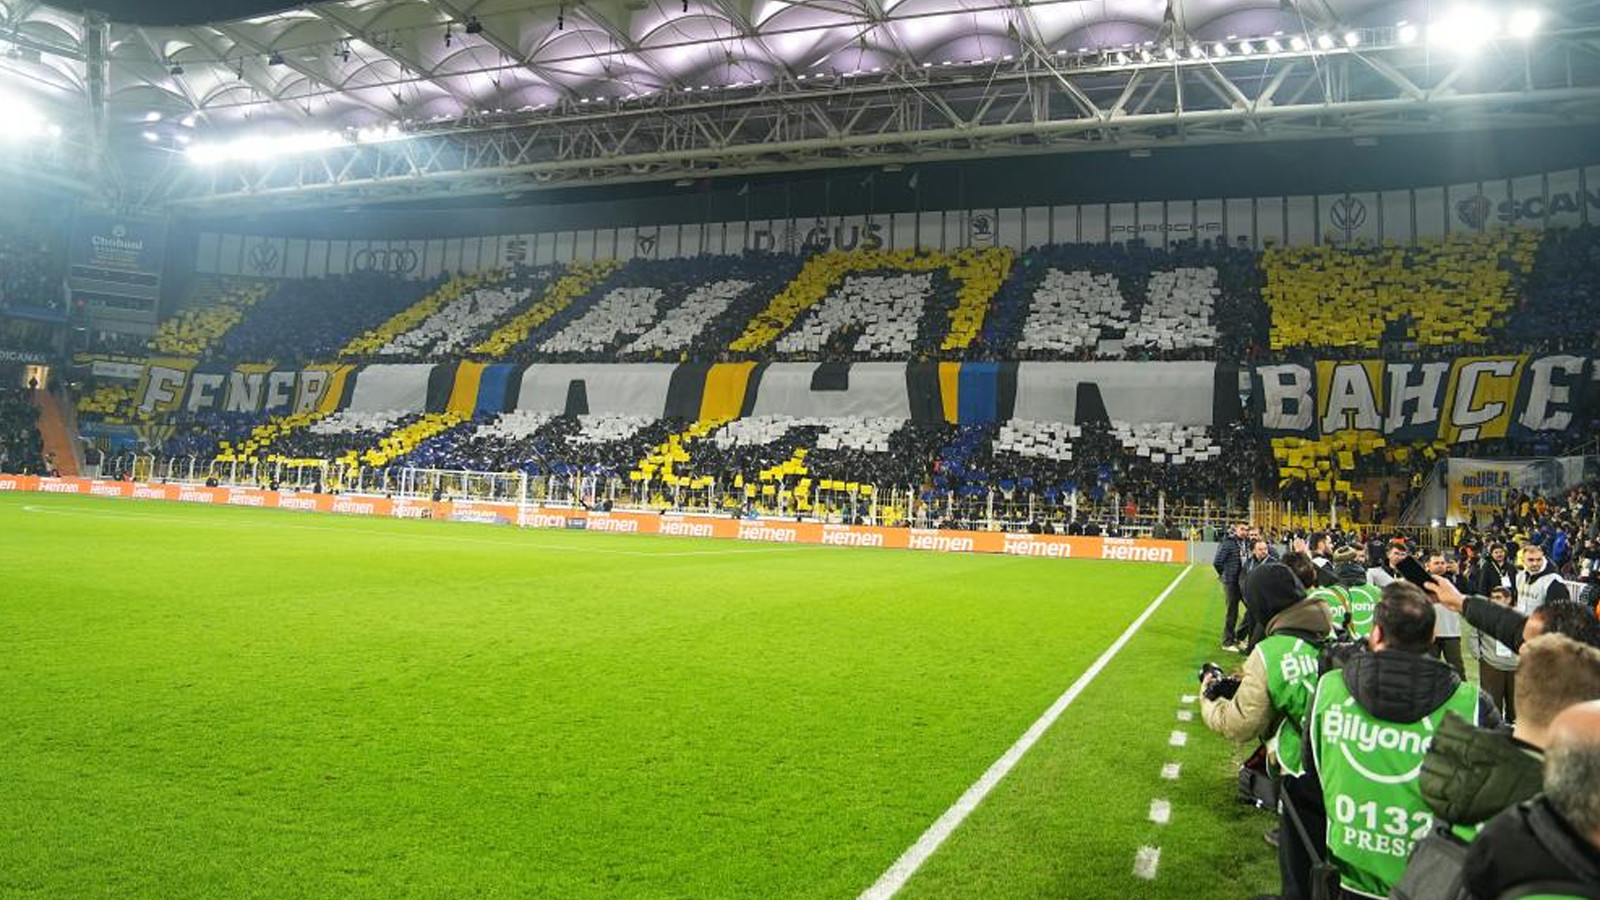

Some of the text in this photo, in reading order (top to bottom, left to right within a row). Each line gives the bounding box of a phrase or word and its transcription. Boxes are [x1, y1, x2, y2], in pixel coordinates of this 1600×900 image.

[1111, 222, 1221, 233] PORSCHE
[1256, 355, 1587, 442] BAHÇE
[278, 496, 317, 511] Hemen
[332, 500, 374, 514] Hemen
[586, 516, 638, 532] Hemen
[659, 520, 713, 537] Hemen
[738, 525, 796, 542] Hemen
[822, 529, 883, 546] Hemen
[908, 533, 973, 551] Hemen
[1004, 539, 1071, 558] Hemen
[1102, 545, 1173, 562] Hemen
[1335, 794, 1434, 840] 0132
